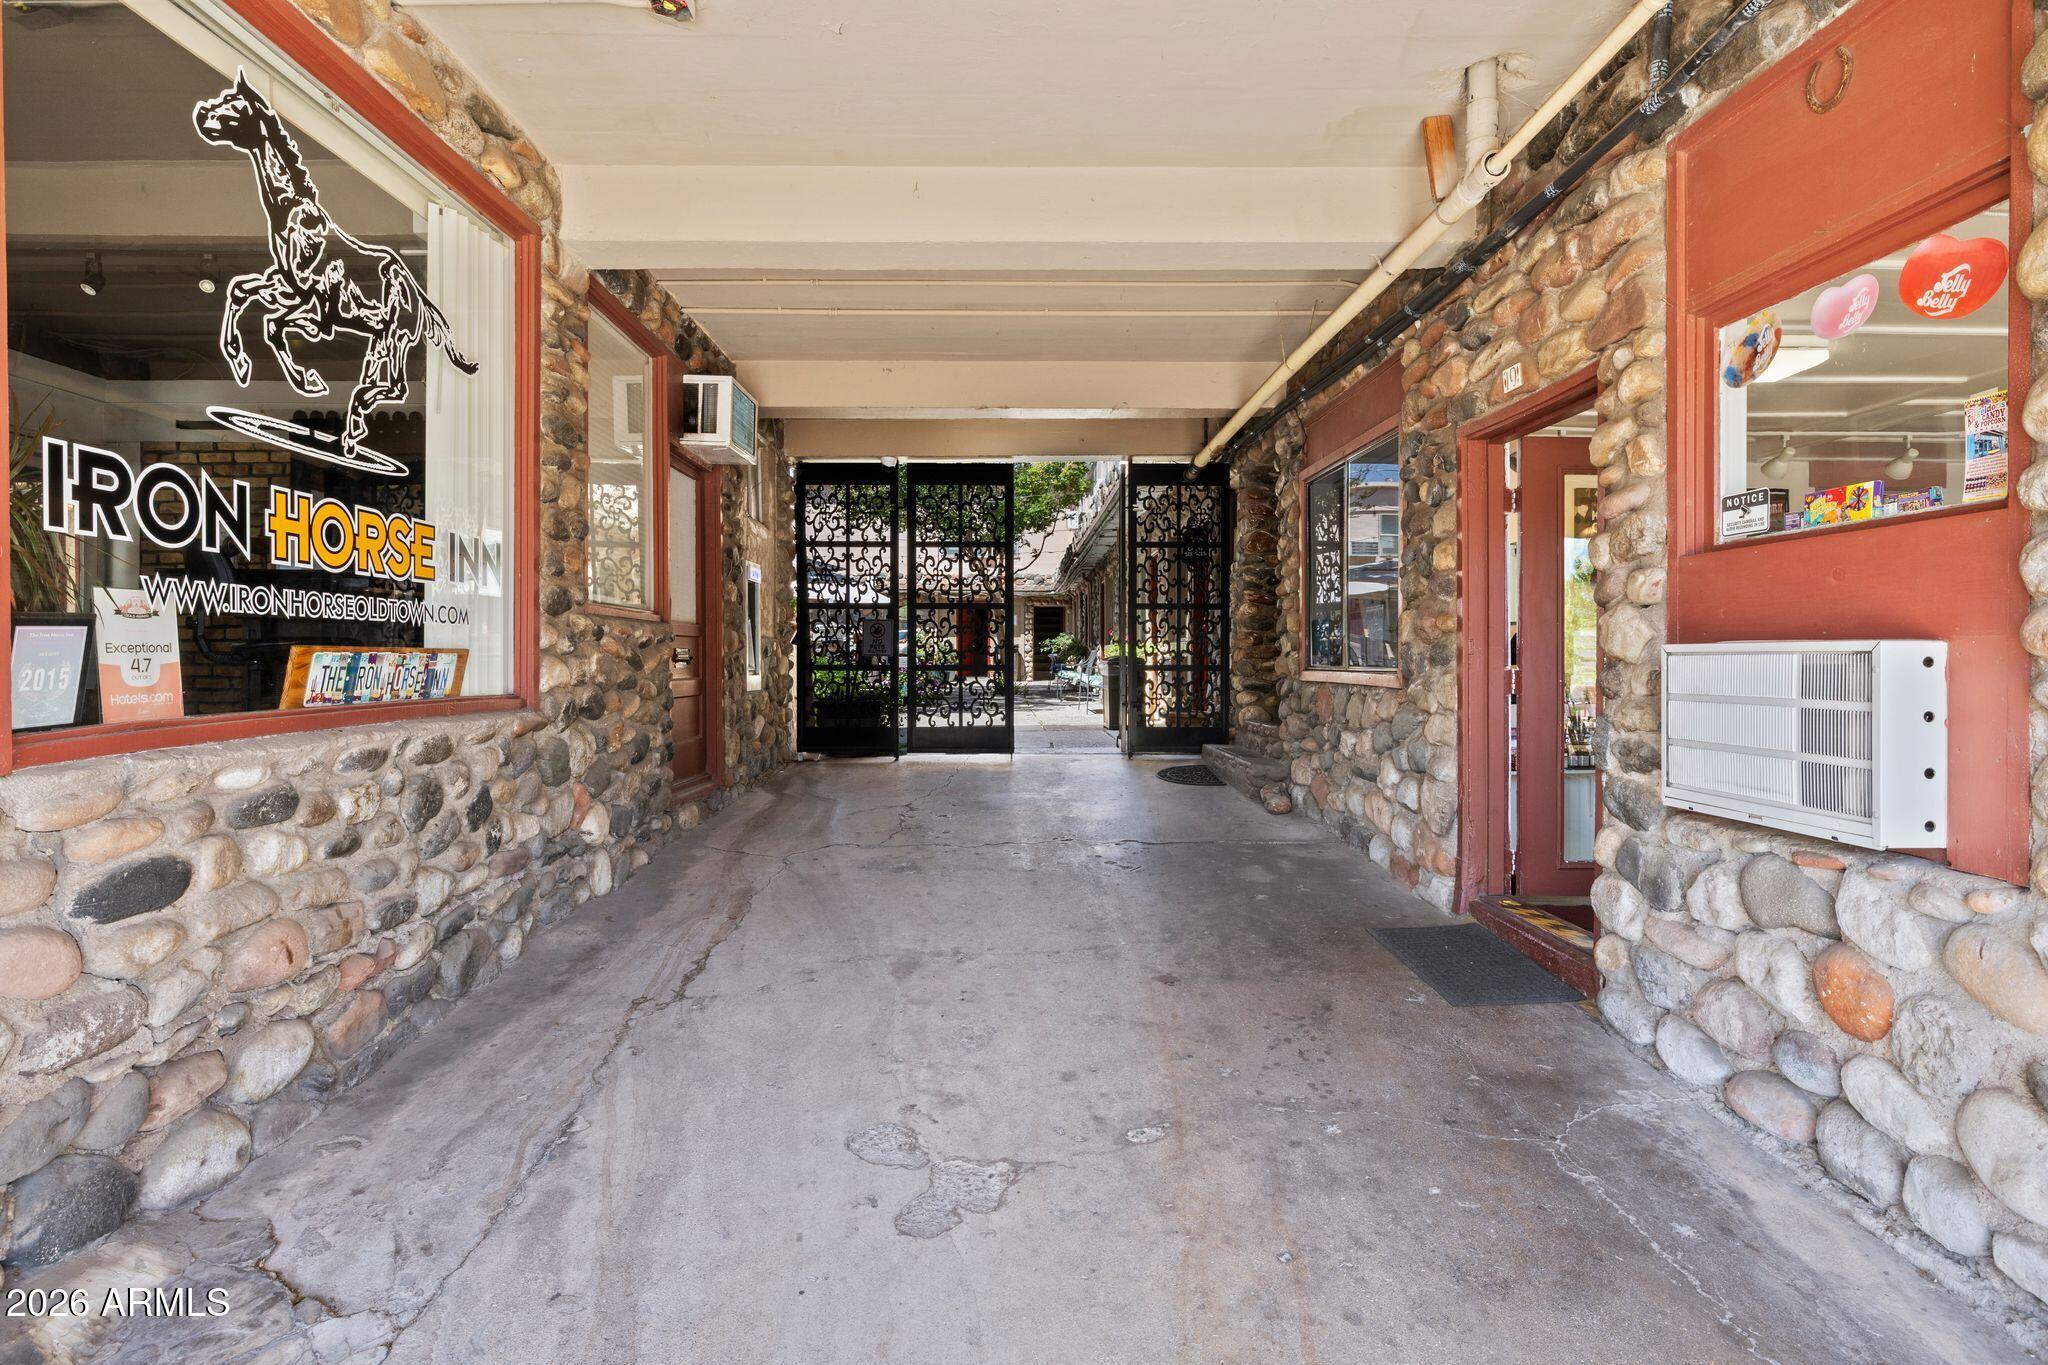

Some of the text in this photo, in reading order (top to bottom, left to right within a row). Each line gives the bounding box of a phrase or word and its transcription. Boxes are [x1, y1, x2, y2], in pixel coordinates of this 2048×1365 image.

[1933, 263, 1972, 298] Jelly
[1849, 287, 1870, 313] Jelly
[1917, 290, 1960, 317] Belly
[1839, 310, 1864, 333] Belly
[1980, 416, 2006, 427] POPCORN
[1982, 408, 2006, 421] CANDY
[1726, 492, 1764, 508] NOTICE
[42, 435, 502, 590] IRON HORSE INN
[139, 571, 470, 627] WWW.IRONHORSEOLDTOWN.COM
[105, 643, 172, 655] Exceptional
[131, 658, 151, 673] 4.7
[18, 666, 71, 692] 2015
[321, 665, 347, 693] THE
[385, 665, 423, 696] HORSE
[110, 691, 173, 705] Hotels.com
